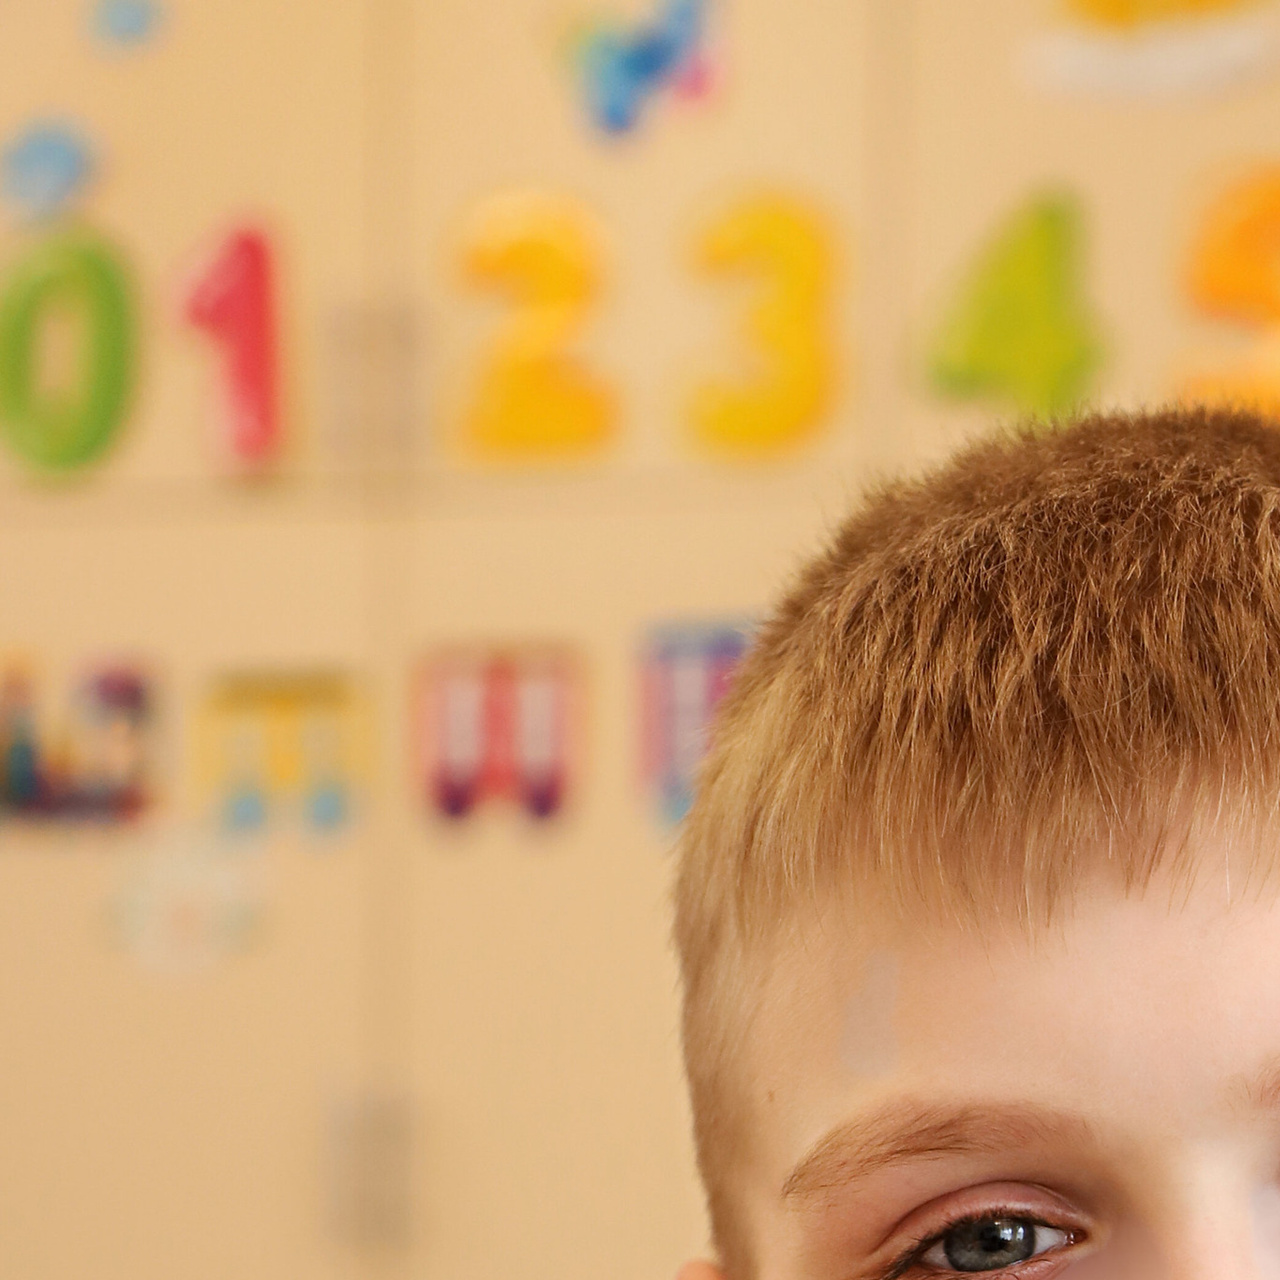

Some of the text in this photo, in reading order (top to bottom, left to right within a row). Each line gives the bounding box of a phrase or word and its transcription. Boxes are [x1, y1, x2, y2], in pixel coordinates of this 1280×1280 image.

[182, 222, 286, 474] 1
[458, 196, 622, 464] 2
[688, 188, 840, 462] 3
[925, 185, 1108, 424] 4
